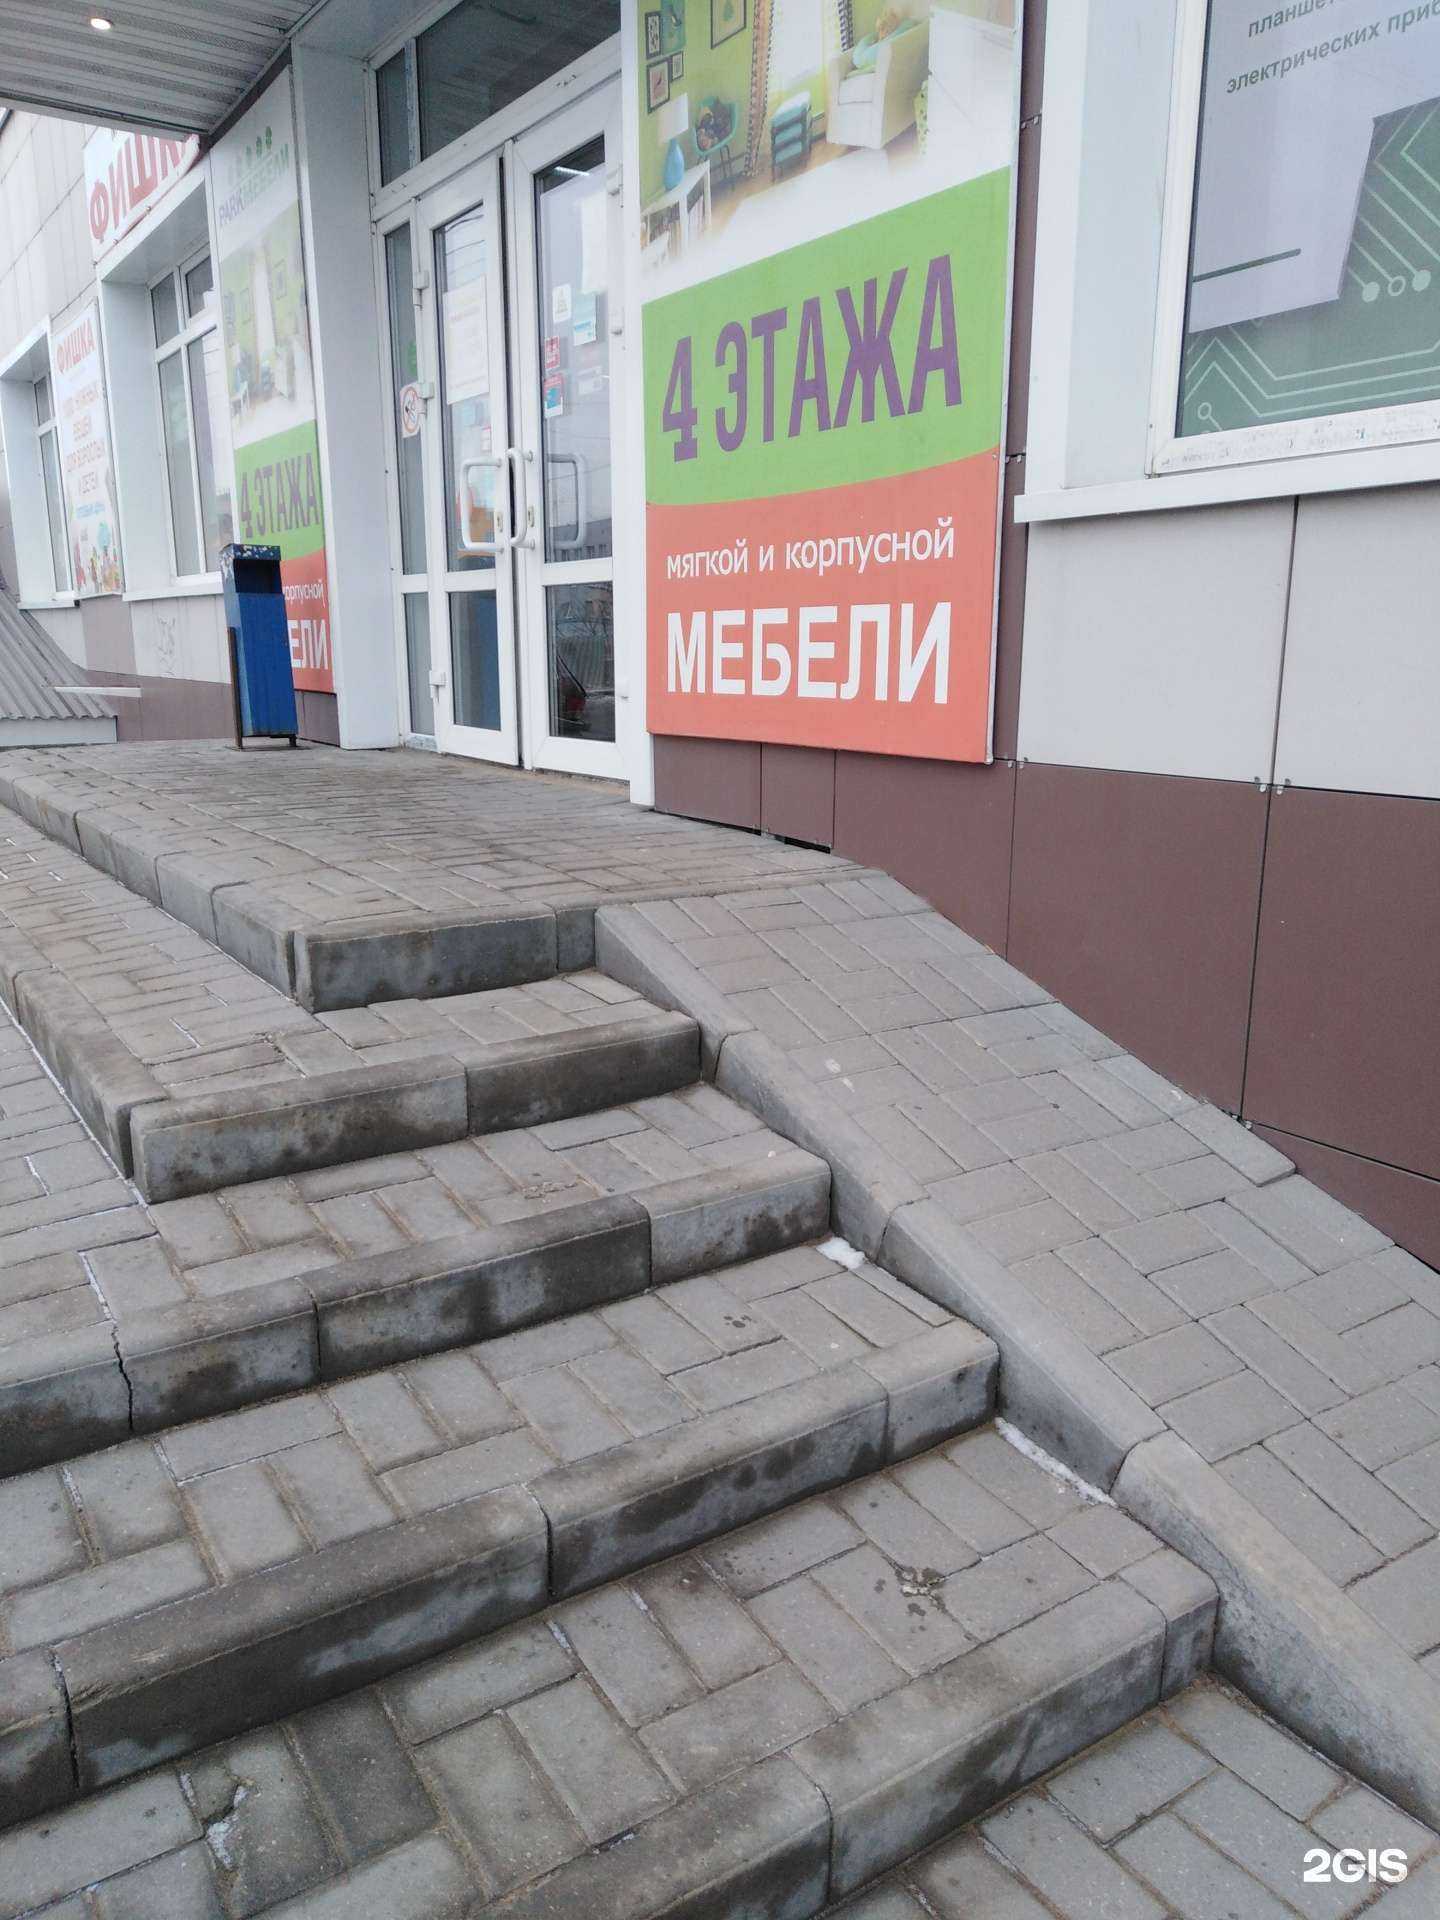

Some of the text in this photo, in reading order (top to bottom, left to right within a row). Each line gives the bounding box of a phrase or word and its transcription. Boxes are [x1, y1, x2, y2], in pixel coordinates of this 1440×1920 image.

[1248, 0, 1333, 37] планше
[1226, 22, 1381, 94] электрических
[662, 255, 962, 462] 4 ЭТАЖА
[240, 452, 320, 539] 4 ЭТАЖА
[667, 517, 954, 580] мягкой и корпусной
[283, 579, 323, 605] орпусной
[287, 619, 328, 670] ЕЛИ
[667, 602, 951, 704] МЕБЕЛИ
